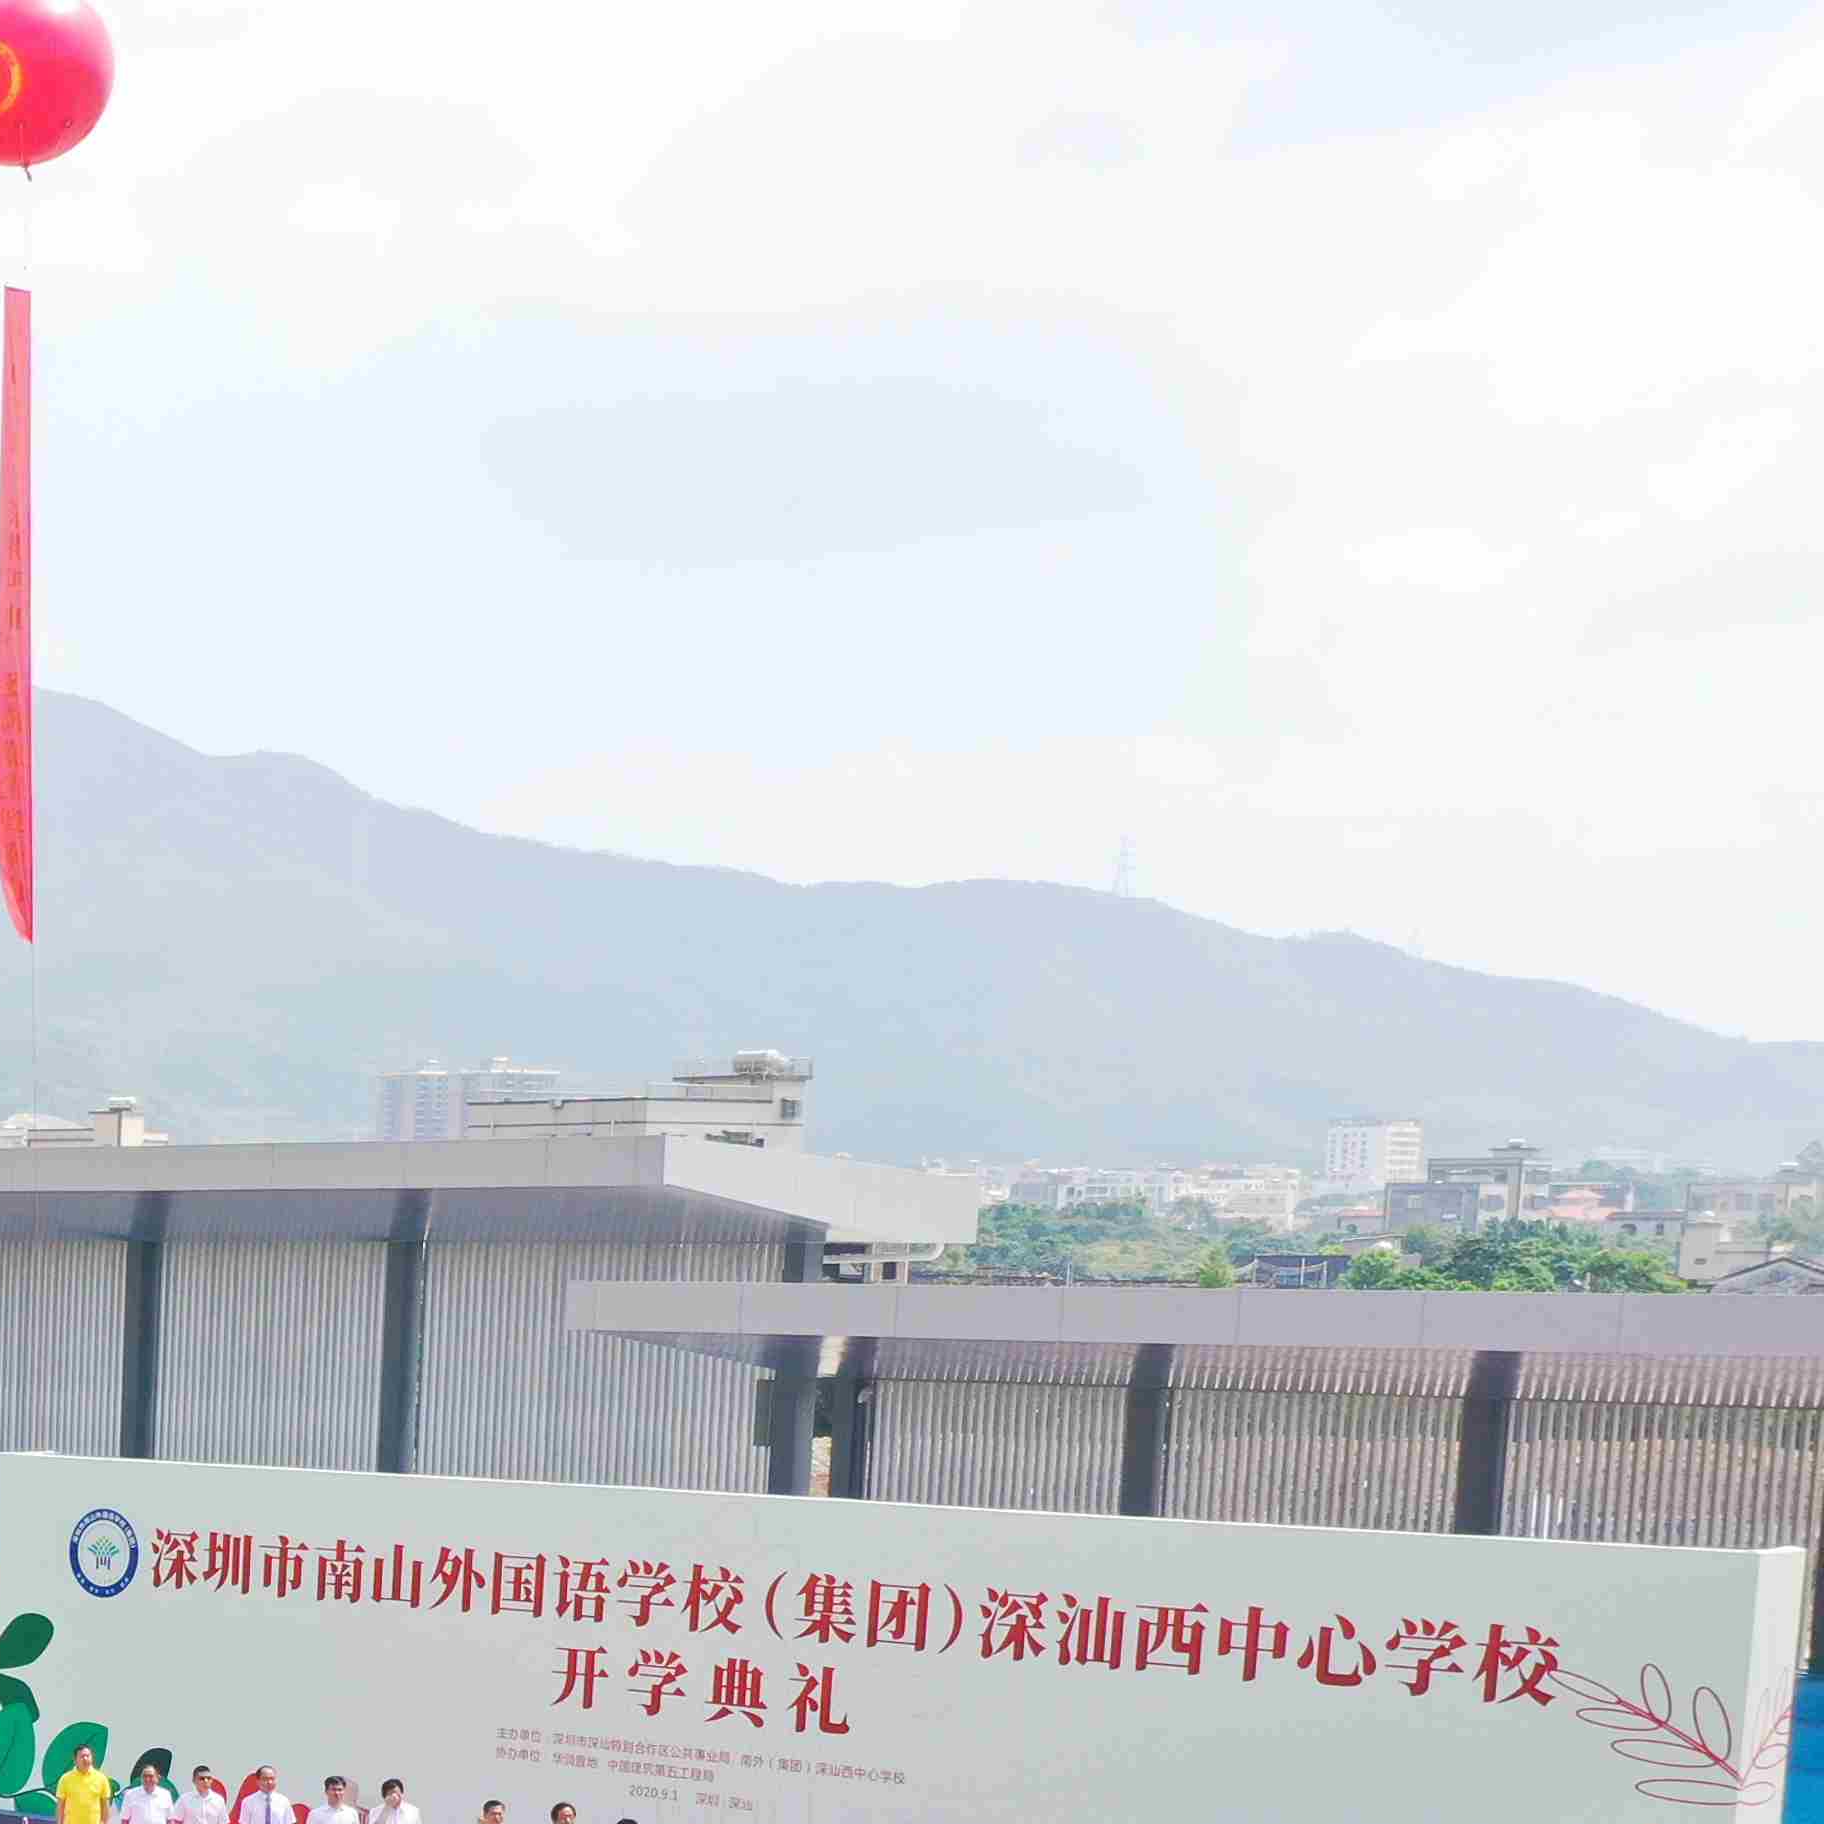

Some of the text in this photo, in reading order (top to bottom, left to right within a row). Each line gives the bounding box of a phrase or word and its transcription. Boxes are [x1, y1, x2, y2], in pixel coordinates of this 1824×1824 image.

[151, 1527, 1561, 1707] 深圳市南山外国语学校（集团）深汕西中心学校
[549, 1645, 850, 1735] 开学典礼
[628, 1784, 679, 1801] 2020.9.1
